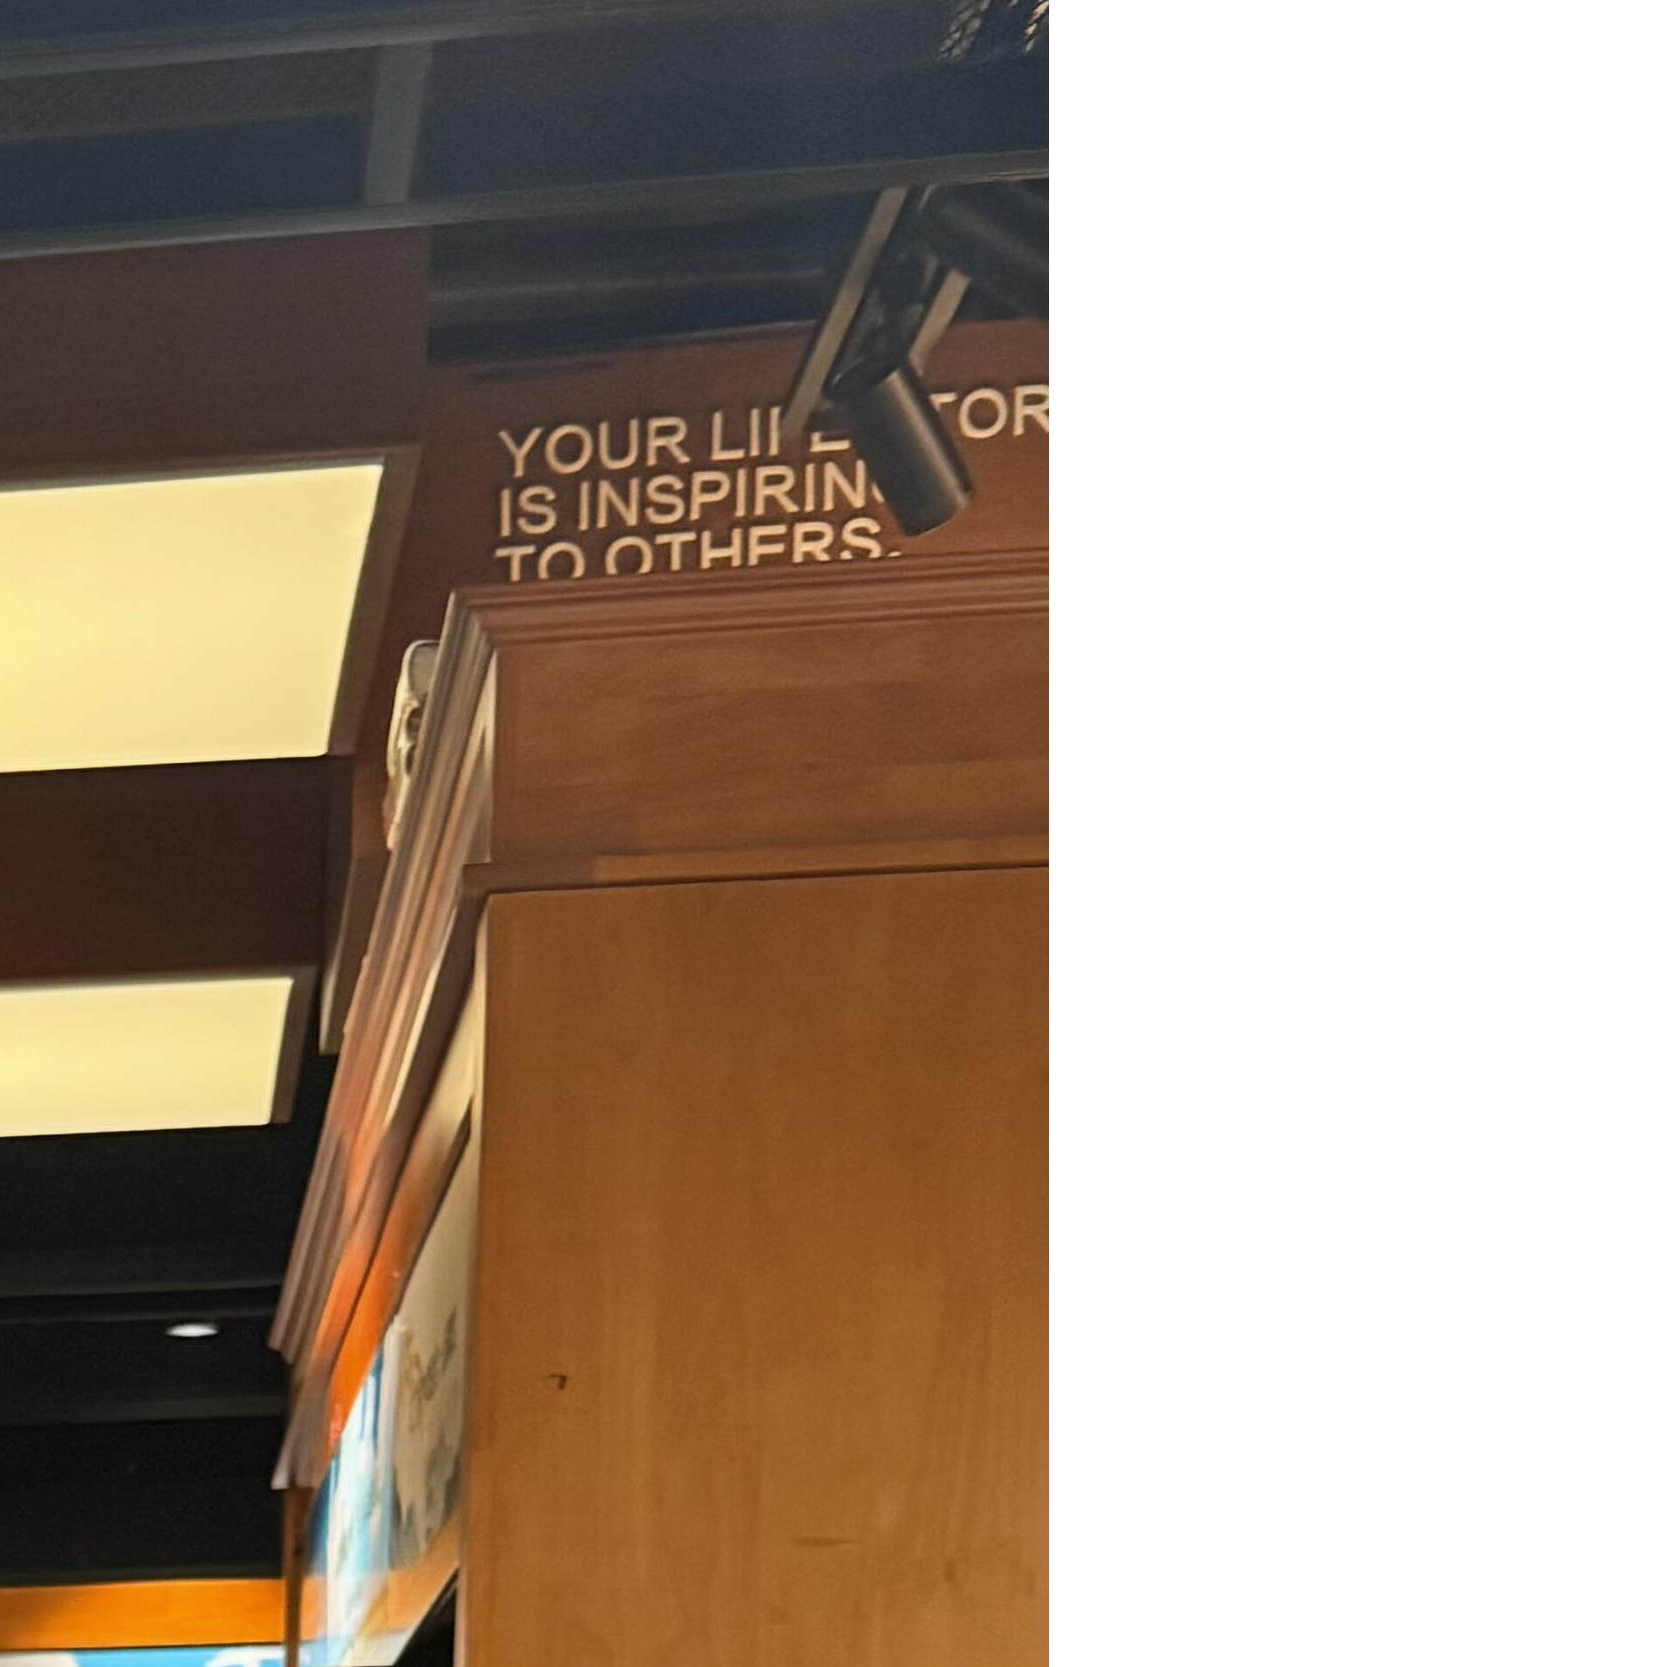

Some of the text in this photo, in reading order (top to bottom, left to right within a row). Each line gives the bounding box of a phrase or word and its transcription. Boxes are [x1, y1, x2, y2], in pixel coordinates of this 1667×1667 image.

[498, 415, 690, 478] YOUR
[498, 459, 885, 537] IS INSPIRIN
[494, 541, 585, 582] TO
